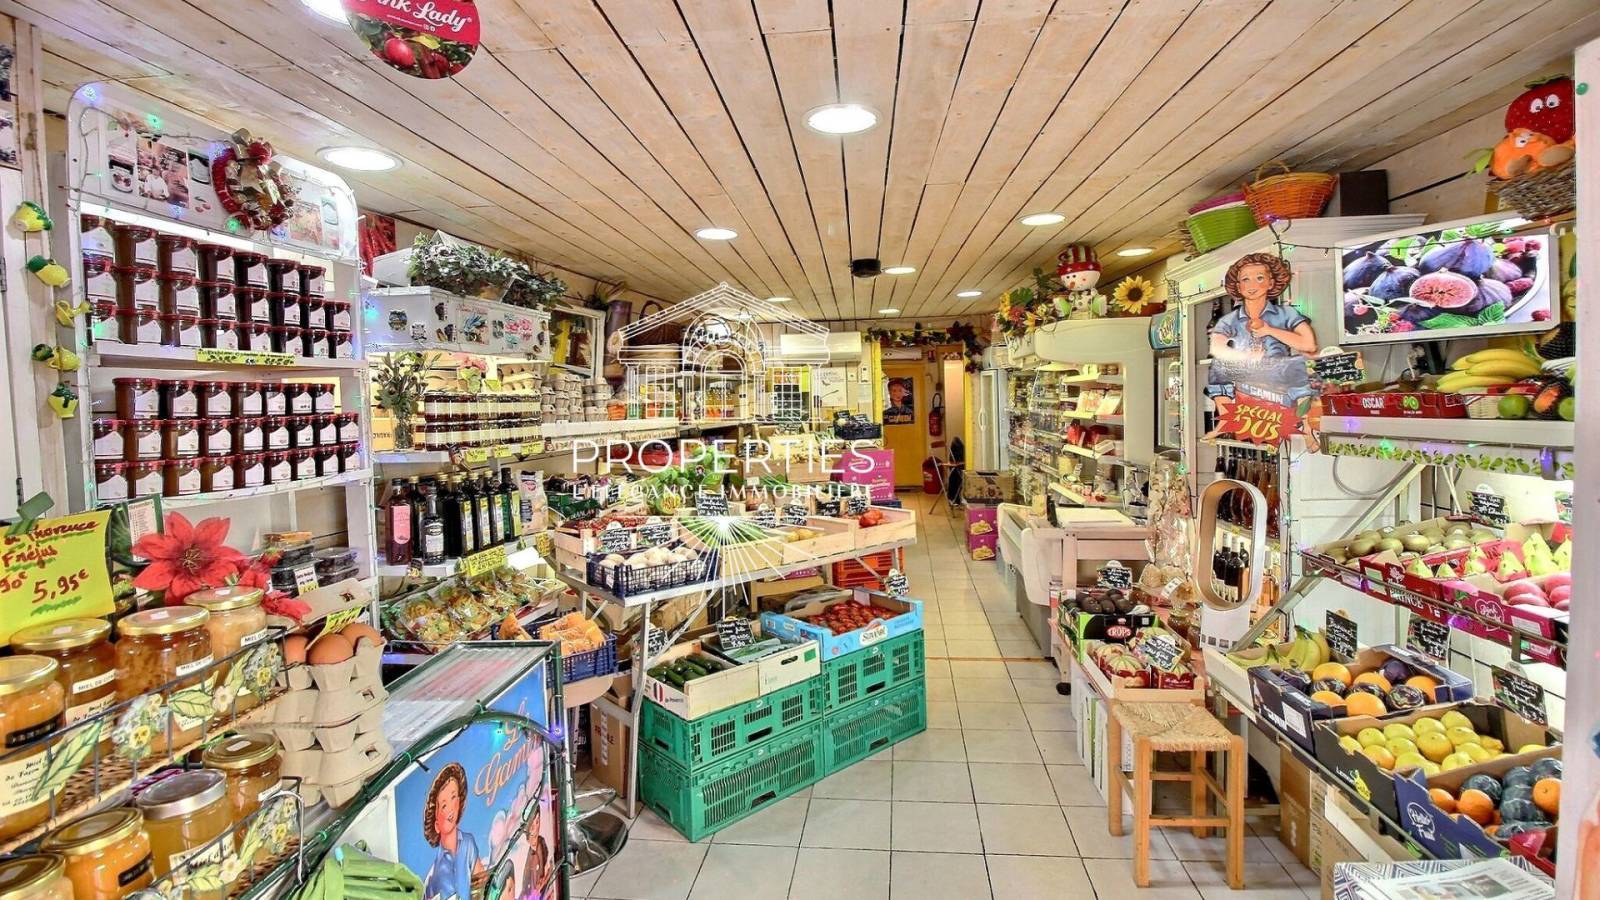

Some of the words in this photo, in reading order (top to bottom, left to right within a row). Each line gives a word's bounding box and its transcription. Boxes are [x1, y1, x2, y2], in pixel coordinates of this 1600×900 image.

[362, 0, 412, 12] nk
[413, 1, 468, 32] Lady
[1362, 397, 1385, 409] OSCAR
[1236, 416, 1280, 440] JUS
